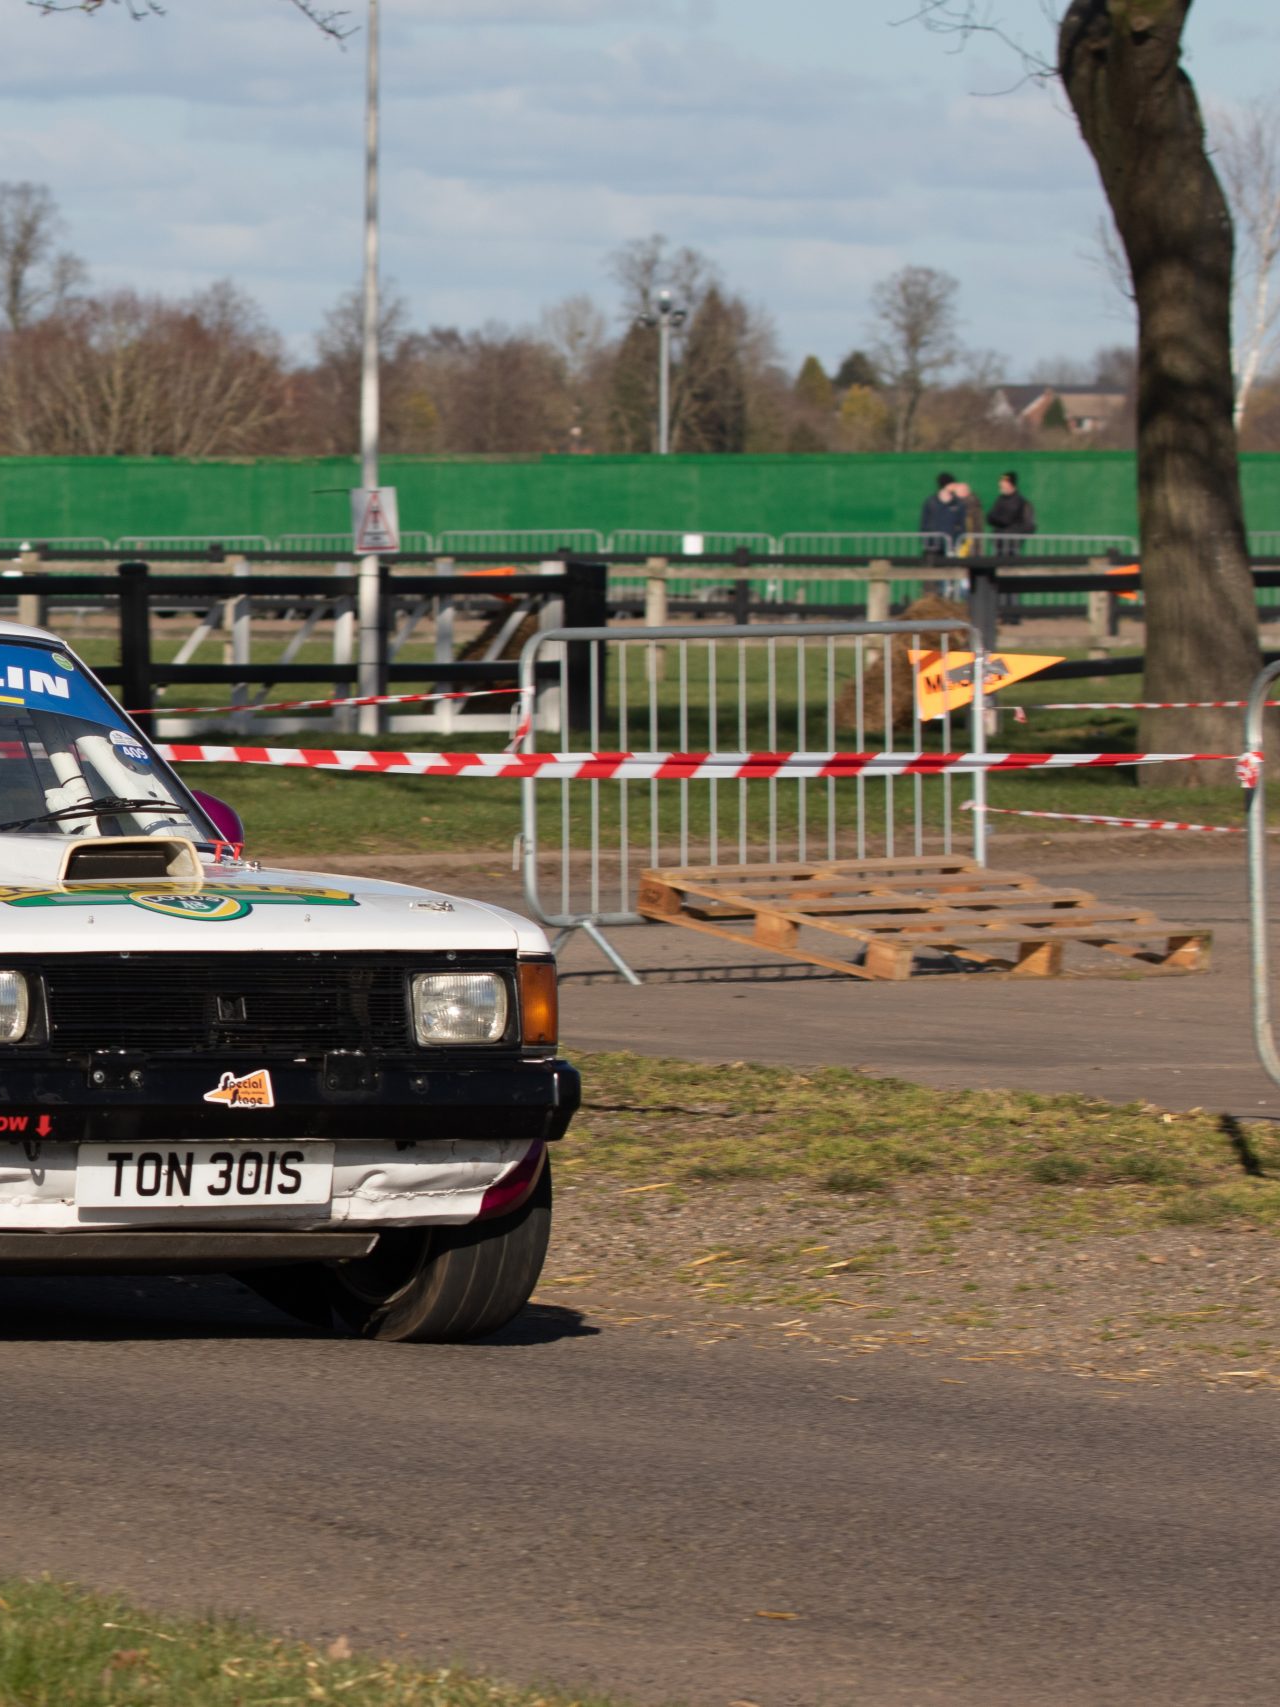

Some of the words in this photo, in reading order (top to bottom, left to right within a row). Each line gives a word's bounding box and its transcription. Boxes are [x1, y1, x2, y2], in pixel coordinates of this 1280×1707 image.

[122, 746, 148, 759] 409
[222, 1075, 262, 1091] Special
[230, 1089, 263, 1107] Stage
[107, 1152, 194, 1197] TON
[207, 1151, 305, 1196] 301S
